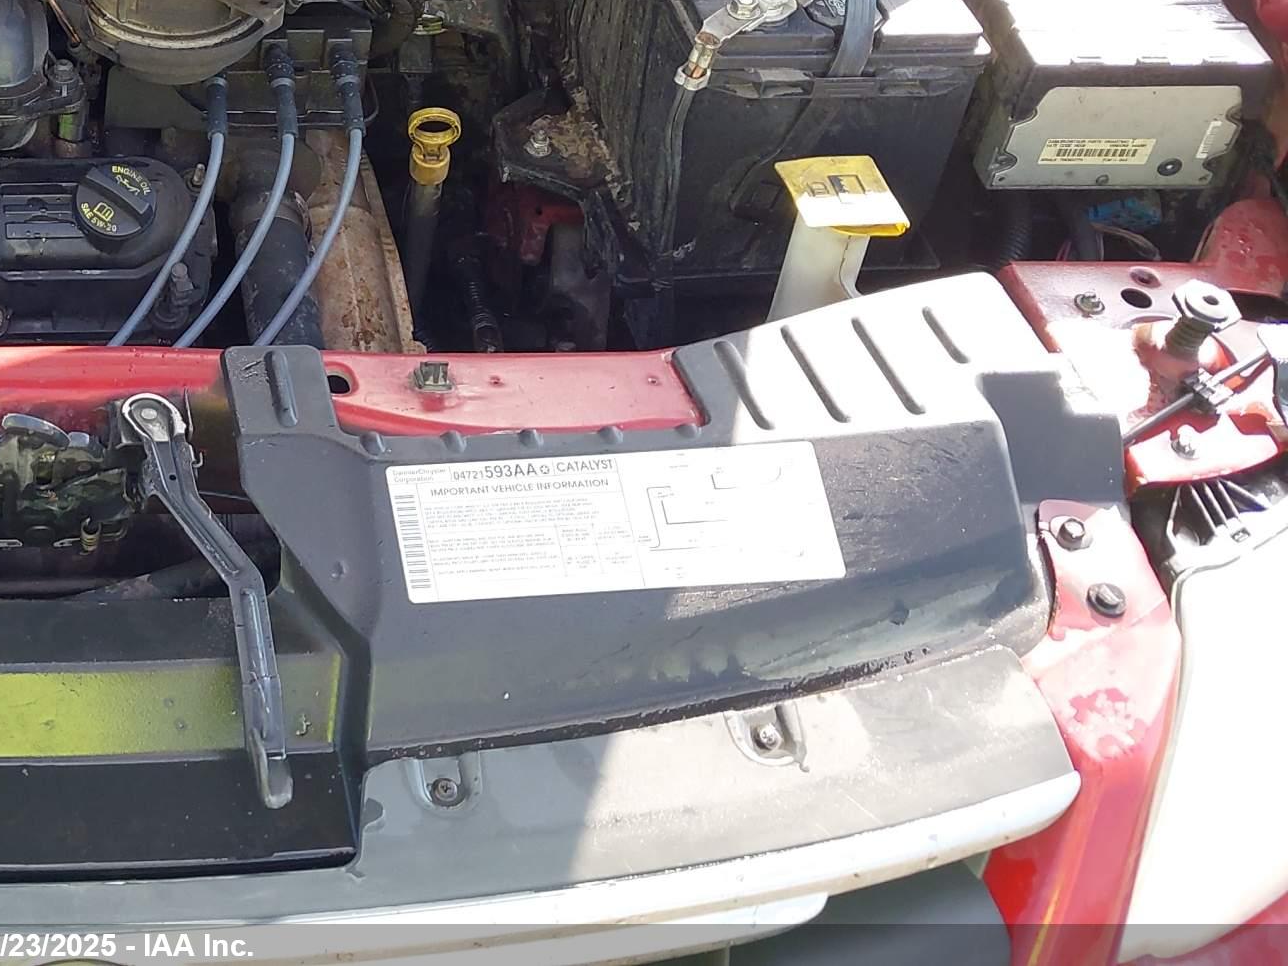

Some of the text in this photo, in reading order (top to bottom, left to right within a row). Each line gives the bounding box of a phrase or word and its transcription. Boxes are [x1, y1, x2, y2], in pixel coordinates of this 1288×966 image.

[112, 166, 151, 195] ENGINE OIL
[81, 203, 117, 232] SAE 5W-20
[556, 459, 614, 473] CATALYST
[430, 479, 609, 497] IMPORTANT VEHICLE INFORMATION
